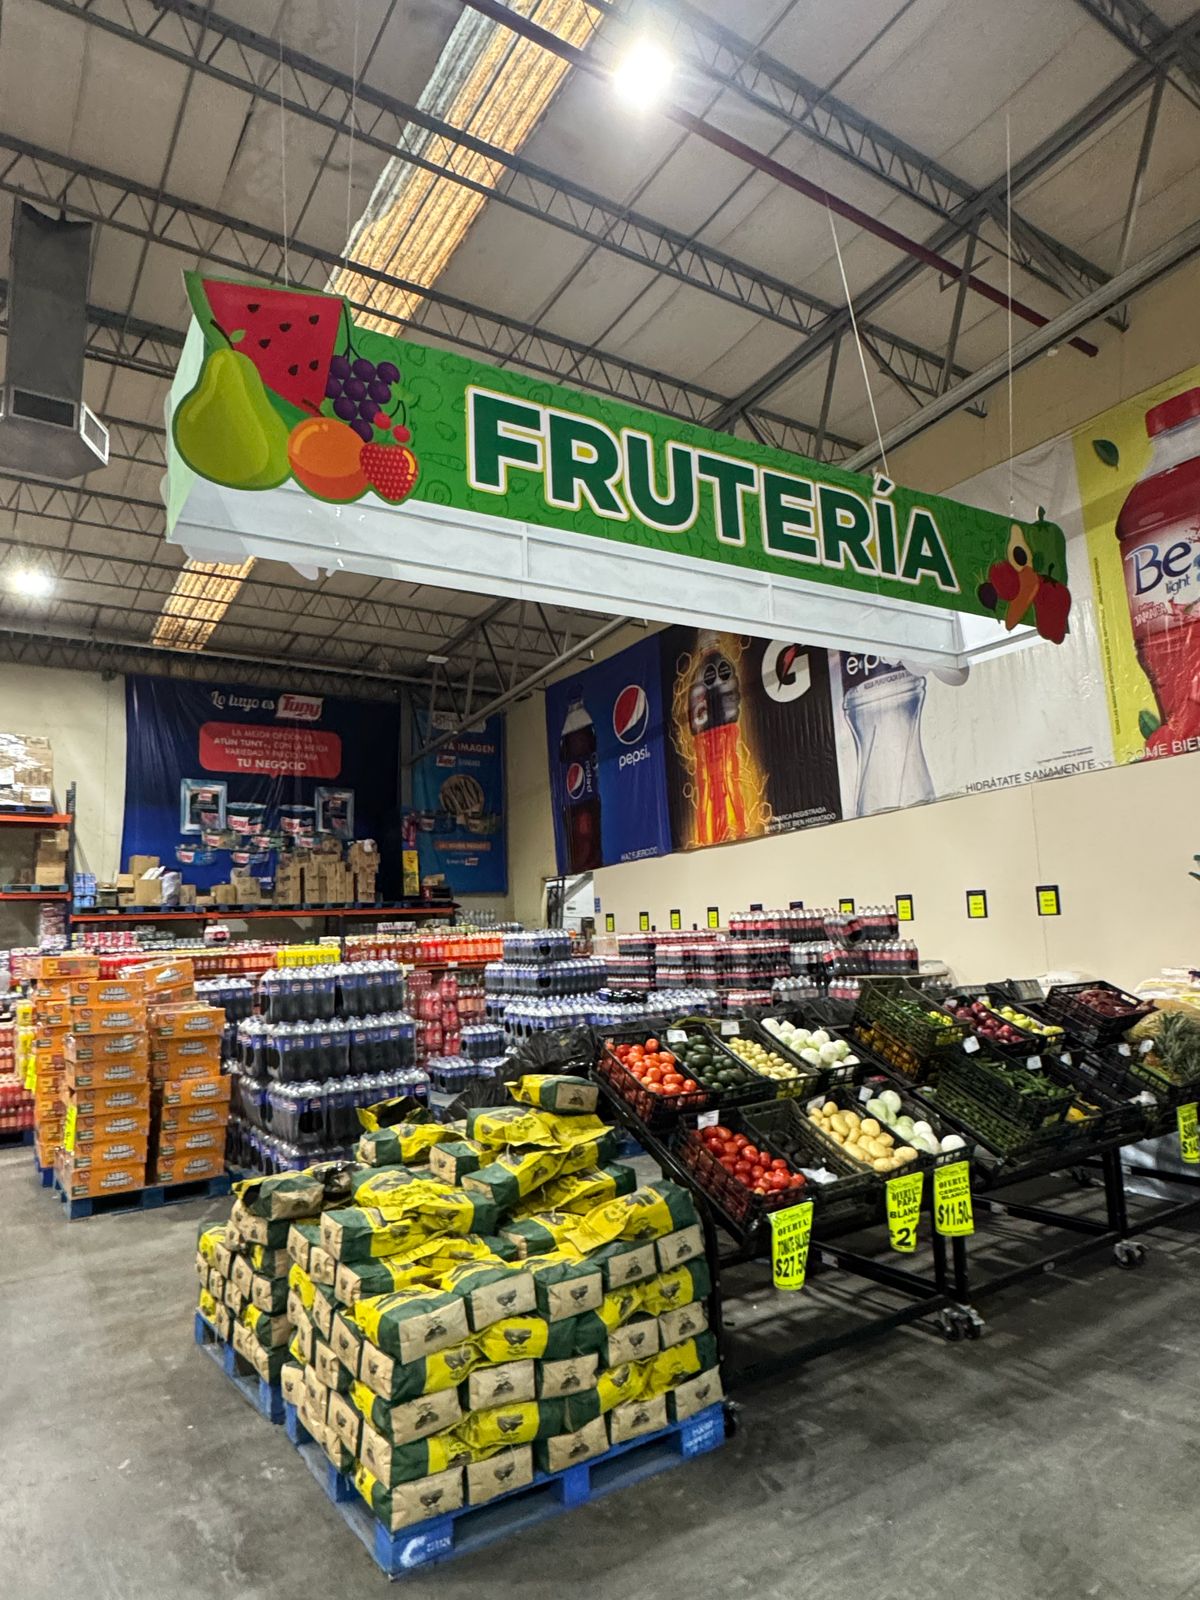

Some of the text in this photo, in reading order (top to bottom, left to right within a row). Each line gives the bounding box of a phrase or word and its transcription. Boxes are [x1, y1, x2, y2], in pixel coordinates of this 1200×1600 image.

[466, 384, 960, 598] FRUTERÍA
[1125, 542, 1192, 597] Be
[1165, 574, 1190, 596] light
[236, 758, 307, 772] TU NEGOCIO
[618, 744, 648, 771] pepsi
[965, 758, 1095, 794] HIDRÁTATE SANAMENTE
